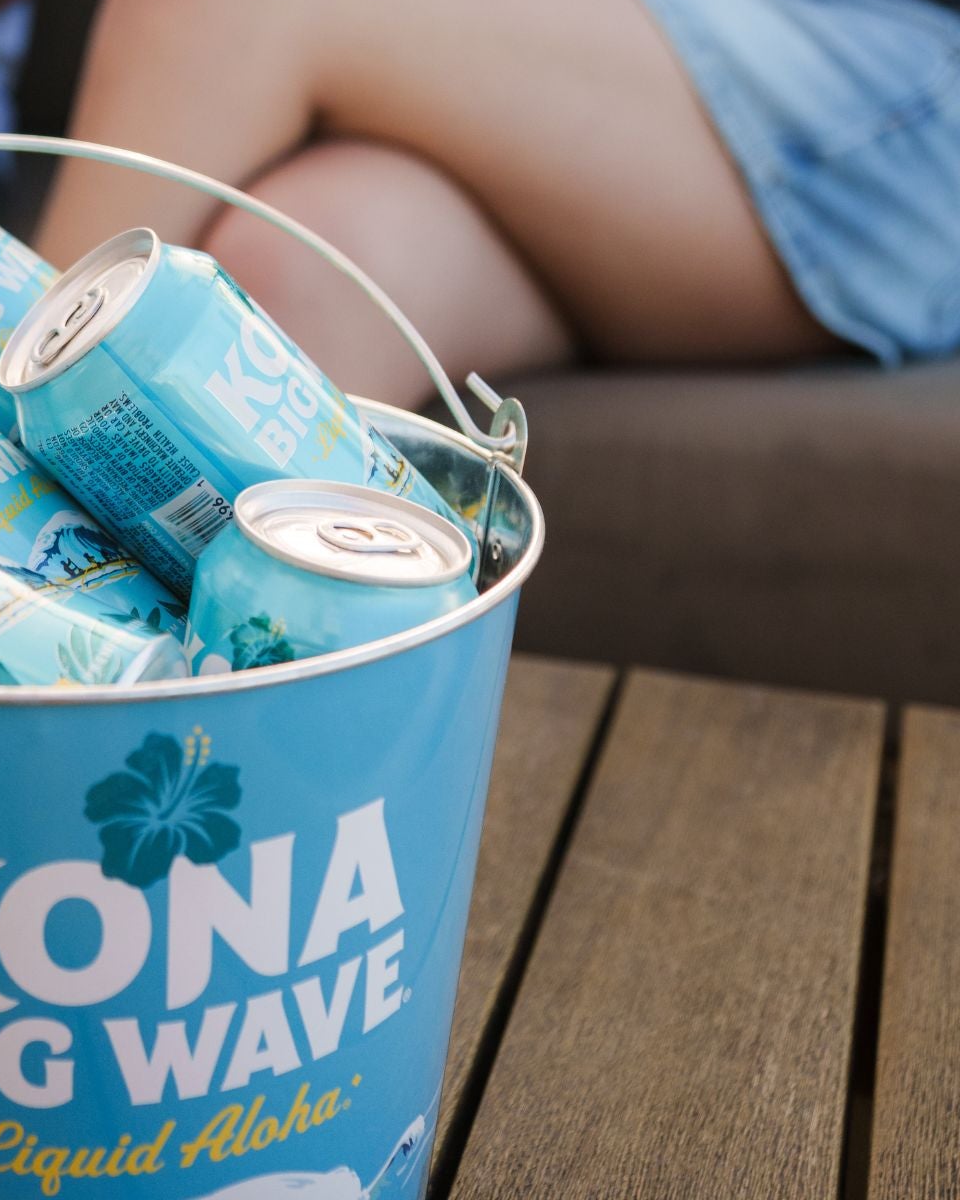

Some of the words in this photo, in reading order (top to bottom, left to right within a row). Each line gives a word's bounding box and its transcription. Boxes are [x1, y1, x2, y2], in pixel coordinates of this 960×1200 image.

[99, 403, 113, 417] OR
[107, 397, 125, 415] MAY
[117, 389, 154, 429] PROBLEMS.
[77, 420, 90, 434] (2)
[91, 409, 111, 432] YOUR
[109, 415, 126, 432] CAR
[119, 411, 137, 427] AND
[253, 376, 319, 469] BIG
[56, 432, 69, 448] NOT
[69, 426, 81, 437] OF
[84, 415, 117, 451] ALCOHOLIC
[122, 429, 132, 438] A
[152, 427, 179, 454] HEALTH
[62, 428, 95, 465] BEVERAGES
[75, 434, 102, 461] BECAUSE
[110, 431, 140, 460] IMPAIRS
[114, 450, 127, 461] OF
[127, 435, 151, 457] DRIVE
[65, 446, 89, 470] SHOULD
[108, 457, 128, 476] BIRTH
[146, 455, 160, 468] TO
[177, 454, 201, 478] CAUSE
[92, 464, 126, 496] ALCOHOLIC
[98, 458, 131, 491] PREGNANCY
[123, 459, 168, 503] CONSUMPTION
[124, 474, 137, 484] OF
[138, 460, 176, 498] BEVERAGES
[156, 465, 185, 491] ABILITY
[164, 457, 193, 485] OPERATE
[132, 482, 149, 496] RISK
[196, 478, 205, 487] 1
[128, 489, 152, 511] DURING
[145, 494, 159, 507] THE
